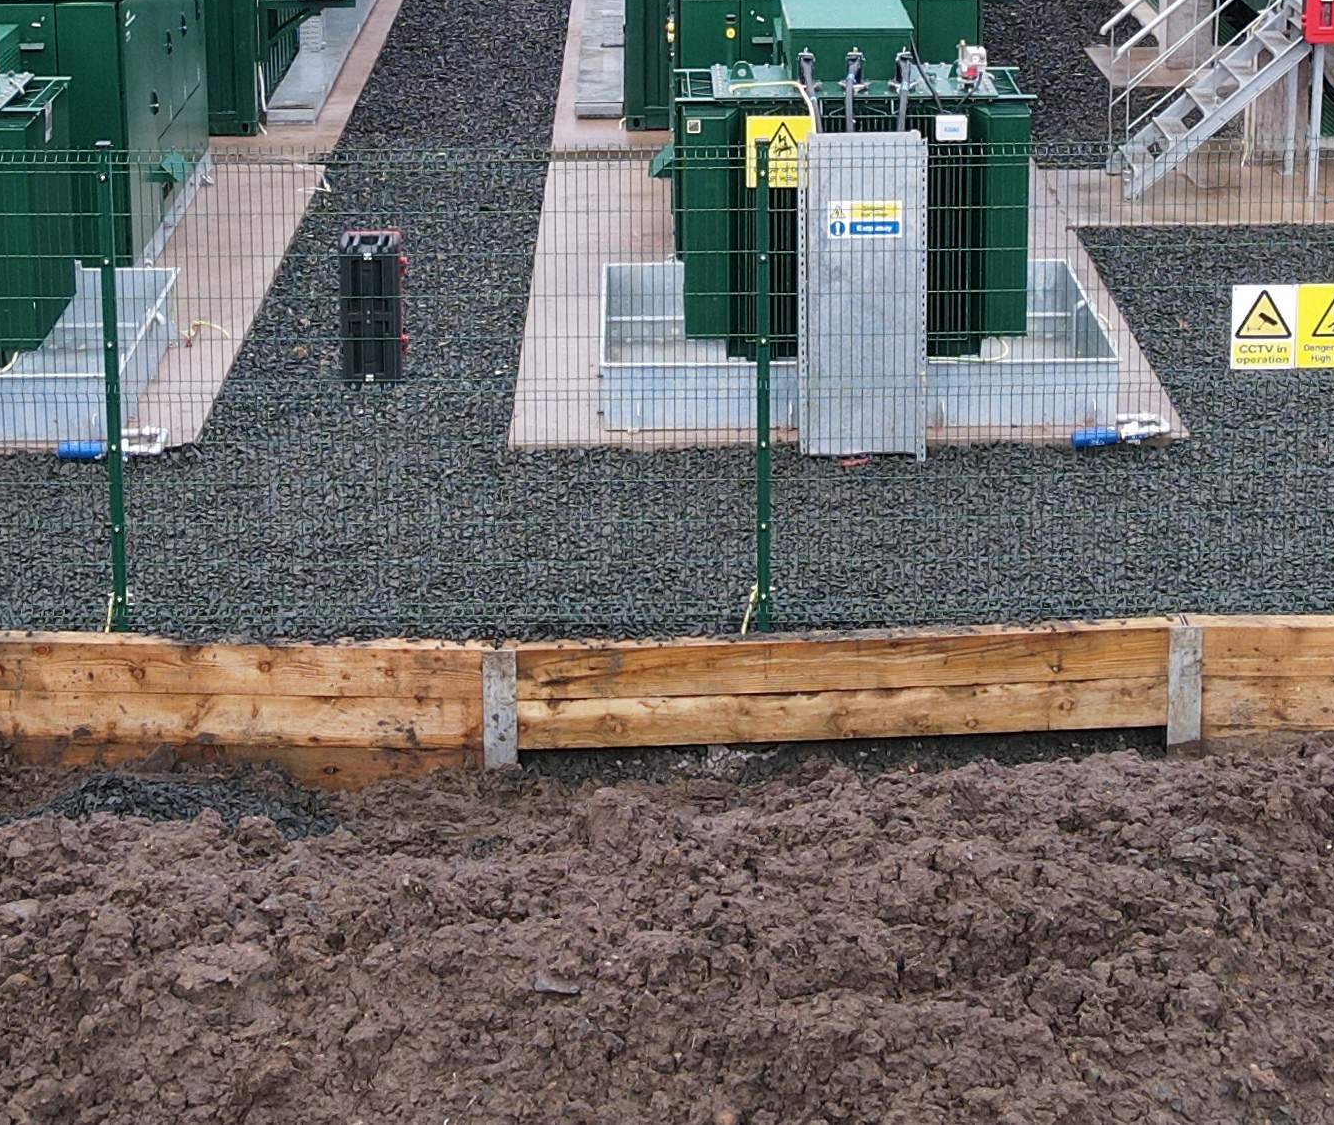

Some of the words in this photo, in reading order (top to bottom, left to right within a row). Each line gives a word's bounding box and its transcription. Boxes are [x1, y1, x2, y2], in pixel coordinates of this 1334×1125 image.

[1239, 344, 1274, 353] CCTV
[1277, 345, 1288, 353] in
[1303, 344, 1334, 353] Danger
[1236, 355, 1290, 365] operation
[1311, 354, 1331, 363] High
